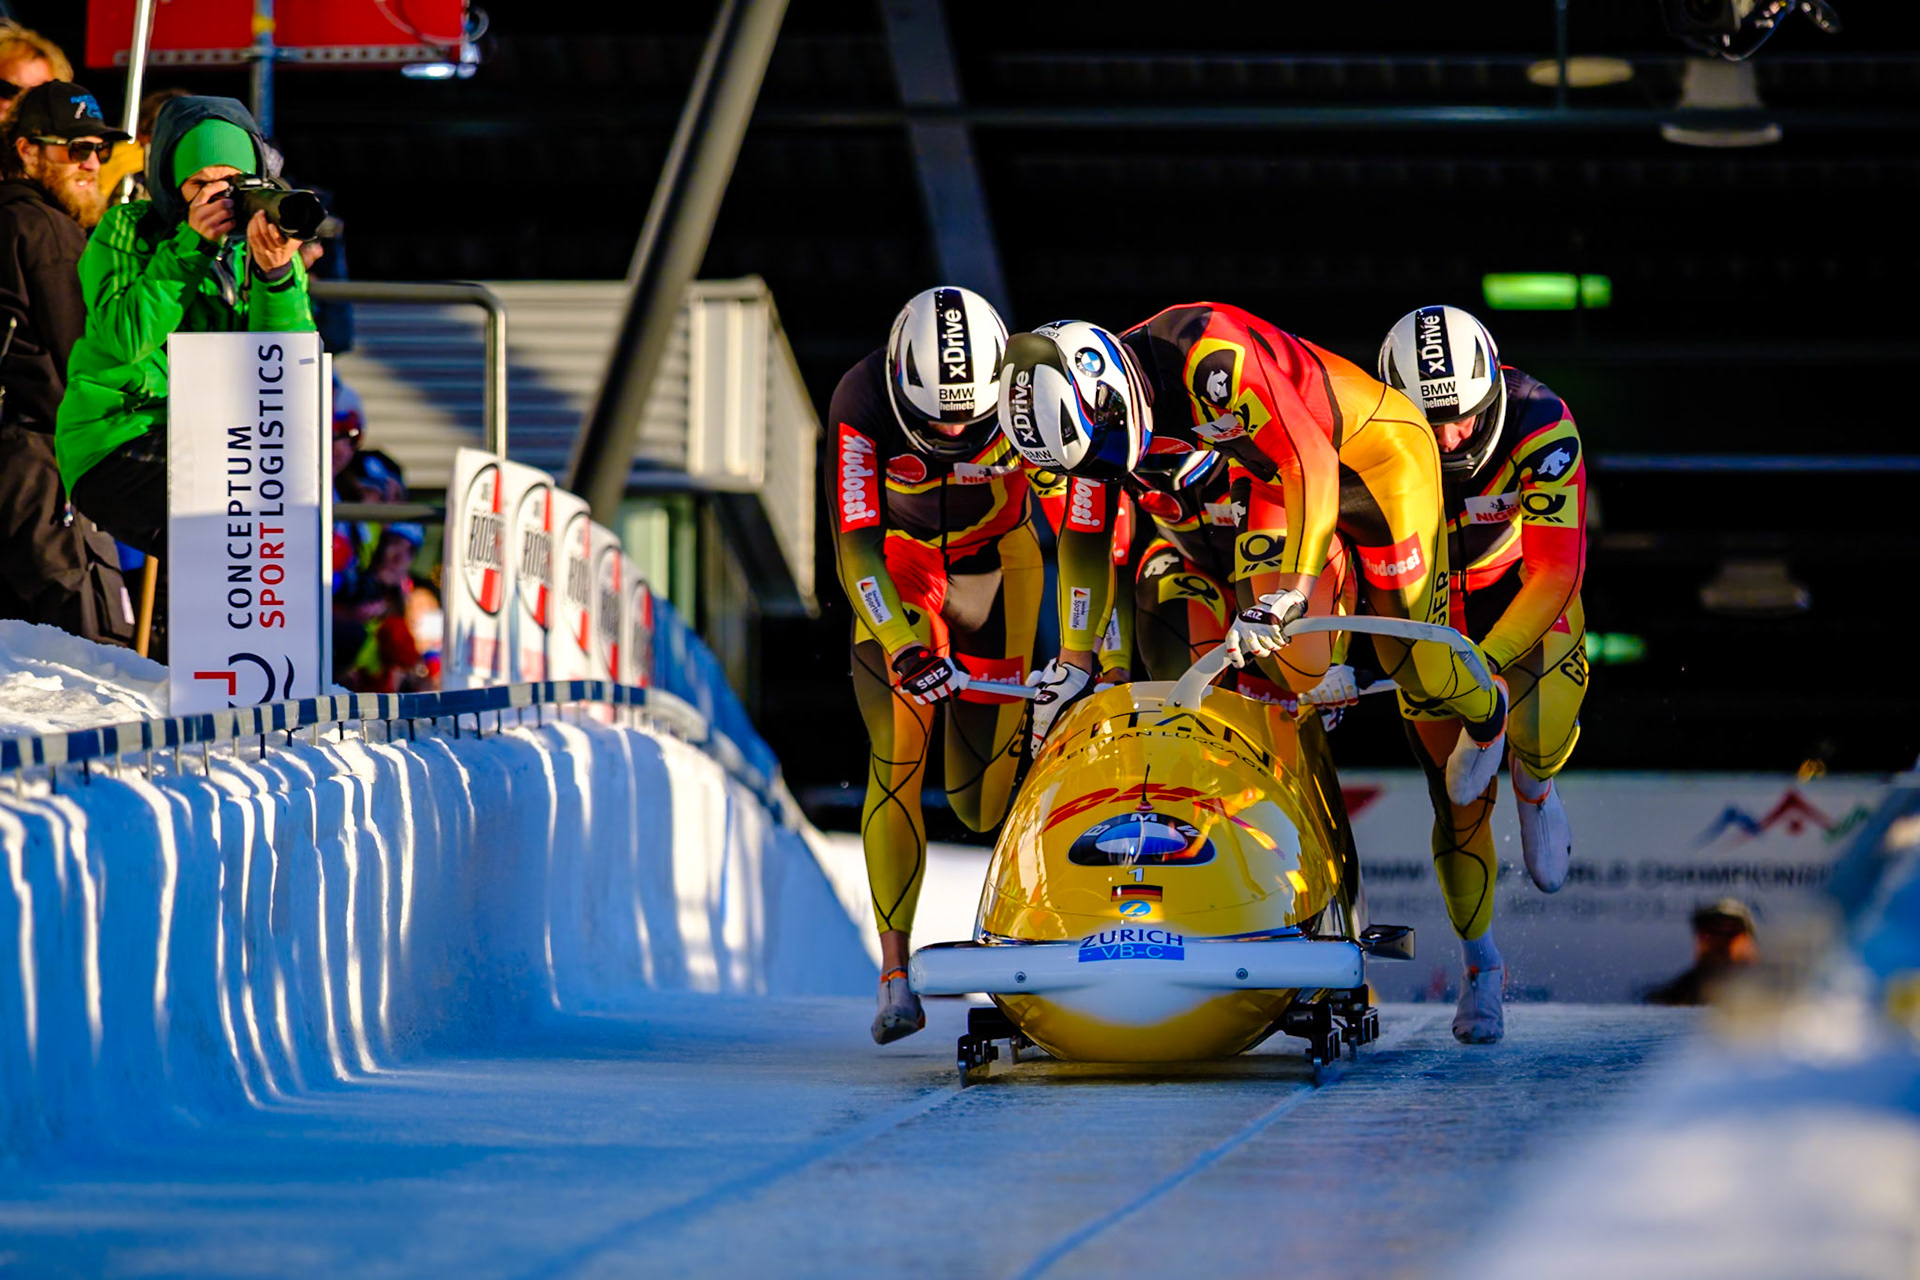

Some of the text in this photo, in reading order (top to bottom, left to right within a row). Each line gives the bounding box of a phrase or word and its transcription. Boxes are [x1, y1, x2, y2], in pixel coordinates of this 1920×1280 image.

[944, 308, 967, 379] xDrive
[1420, 314, 1447, 375] xDrive
[938, 386, 976, 400] BMW
[1419, 381, 1457, 397] BMW
[938, 402, 975, 412] helmets
[1011, 370, 1039, 445] xDrive
[1422, 395, 1460, 410] helmets
[227, 425, 253, 630] CONCEPTUM
[916, 666, 949, 690] SEIZ
[1161, 730, 1269, 778] LUGGAGE
[1127, 867, 1144, 882] 1
[1081, 928, 1184, 949] ZURICH
[1100, 944, 1164, 959] VB-C
